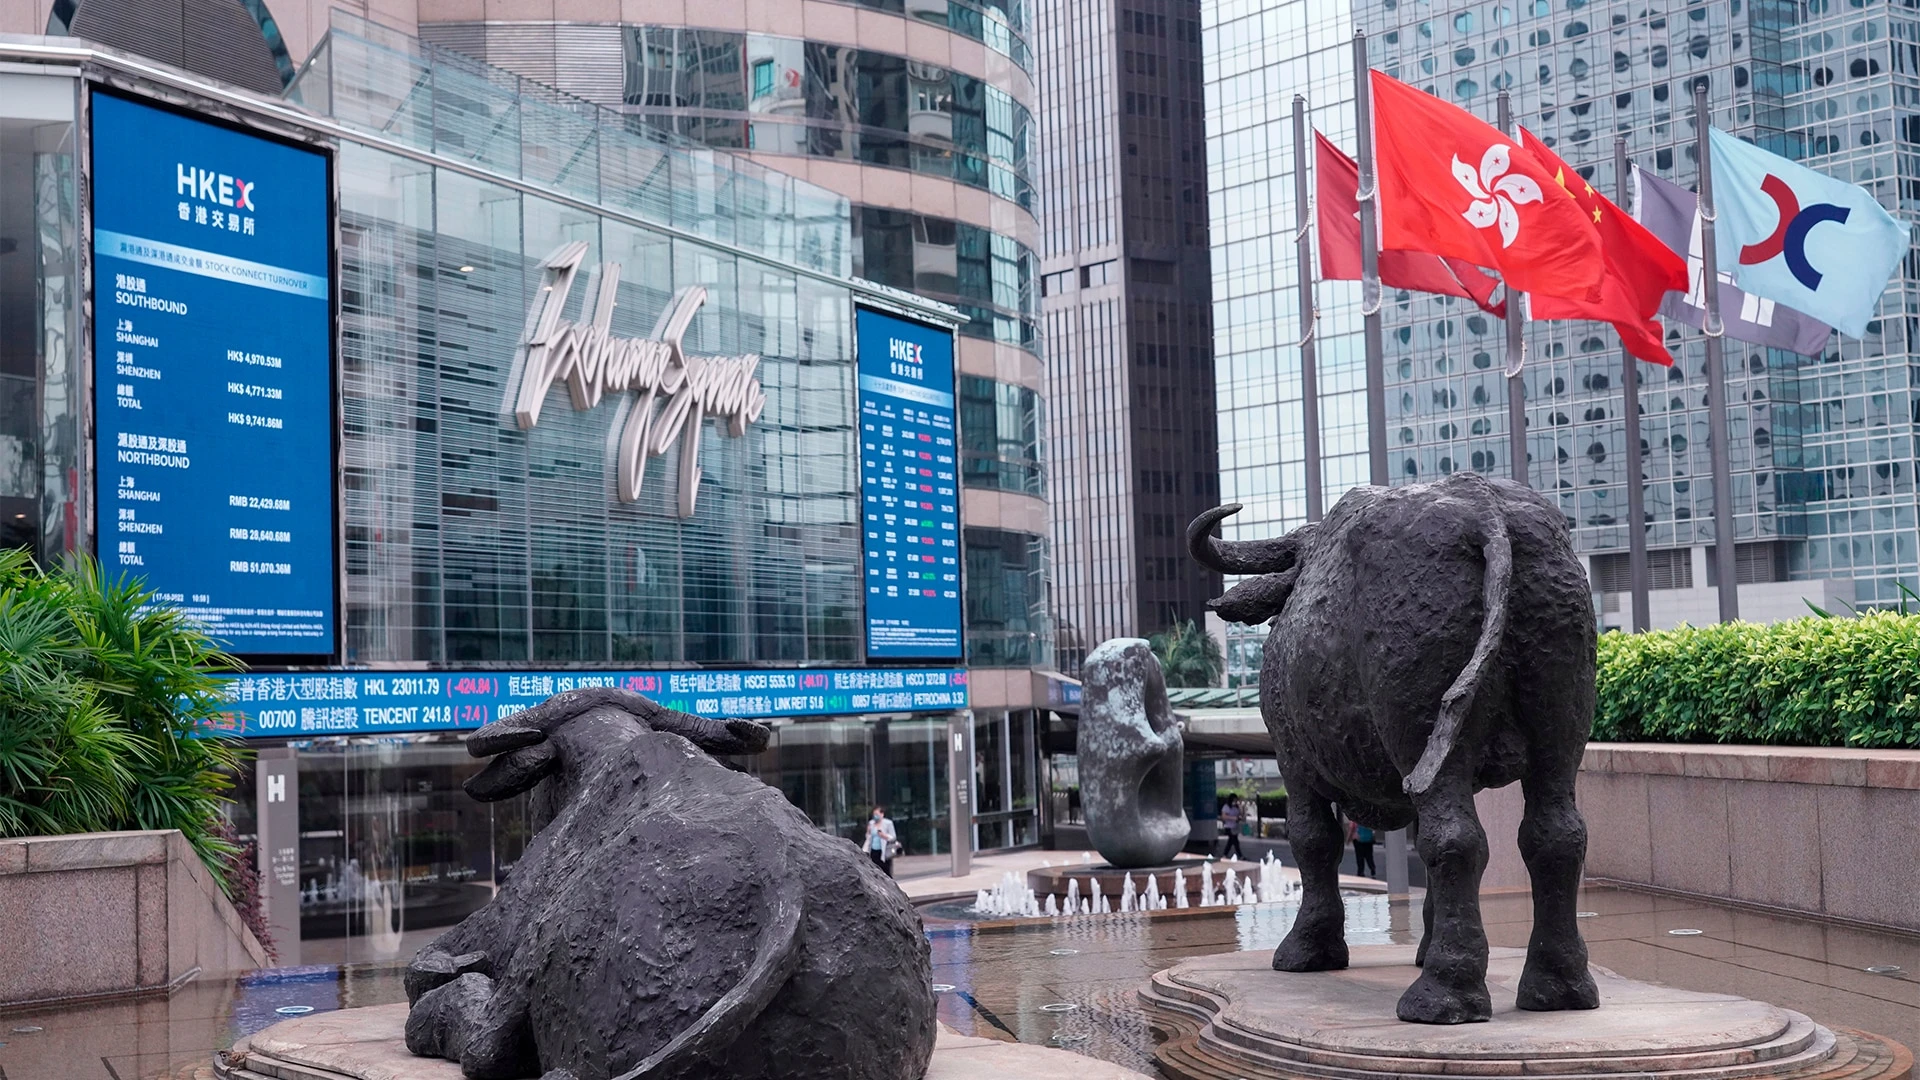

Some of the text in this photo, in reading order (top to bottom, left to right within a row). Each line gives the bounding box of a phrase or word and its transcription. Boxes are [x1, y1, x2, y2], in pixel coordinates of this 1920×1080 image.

[177, 163, 255, 212] HKEX
[178, 201, 255, 236] 香港交易所
[115, 273, 146, 293] 港股通
[204, 261, 230, 274] STOCK
[231, 265, 269, 282] CONNECT
[269, 273, 308, 290] TURNOVER
[115, 292, 188, 315] SOUTHBOUND
[116, 318, 133, 332] 上海
[116, 331, 159, 348] SHANGHAI
[227, 349, 282, 369] HK$ 4,970.53M
[889, 337, 923, 365] HKEX
[116, 364, 161, 380] SHENZHEN
[227, 381, 282, 400] HK$ 4,771.33M
[117, 397, 143, 410] TOTAL
[228, 411, 283, 429] HK$ 9,741.86M
[118, 450, 190, 469] NORTHBOUND
[118, 475, 135, 488] 上海
[117, 488, 160, 502] SHANGHAI
[229, 495, 291, 511] RMB 22,429.68M
[118, 521, 163, 534] SHENZHEN
[229, 527, 291, 543] RMB 28,640.68M
[118, 554, 144, 566] TOTAL
[230, 560, 291, 575] RMB 51,070.36M
[364, 679, 388, 696] HKL
[392, 678, 440, 696] 23011.79
[508, 675, 554, 697] 恒生指數
[577, 676, 615, 690] 1636933
[744, 674, 768, 689] HSCEI
[259, 709, 296, 729] 00700
[301, 706, 359, 730] 騰訊控股
[363, 706, 418, 725] TENCENT
[422, 705, 451, 723] 241.8
[696, 698, 719, 714] 00823
[774, 696, 791, 710] LINK
[791, 695, 808, 710] REIT
[809, 695, 824, 709] 51.6
[914, 692, 951, 706] PETROCHINA
[267, 774, 285, 803] H
